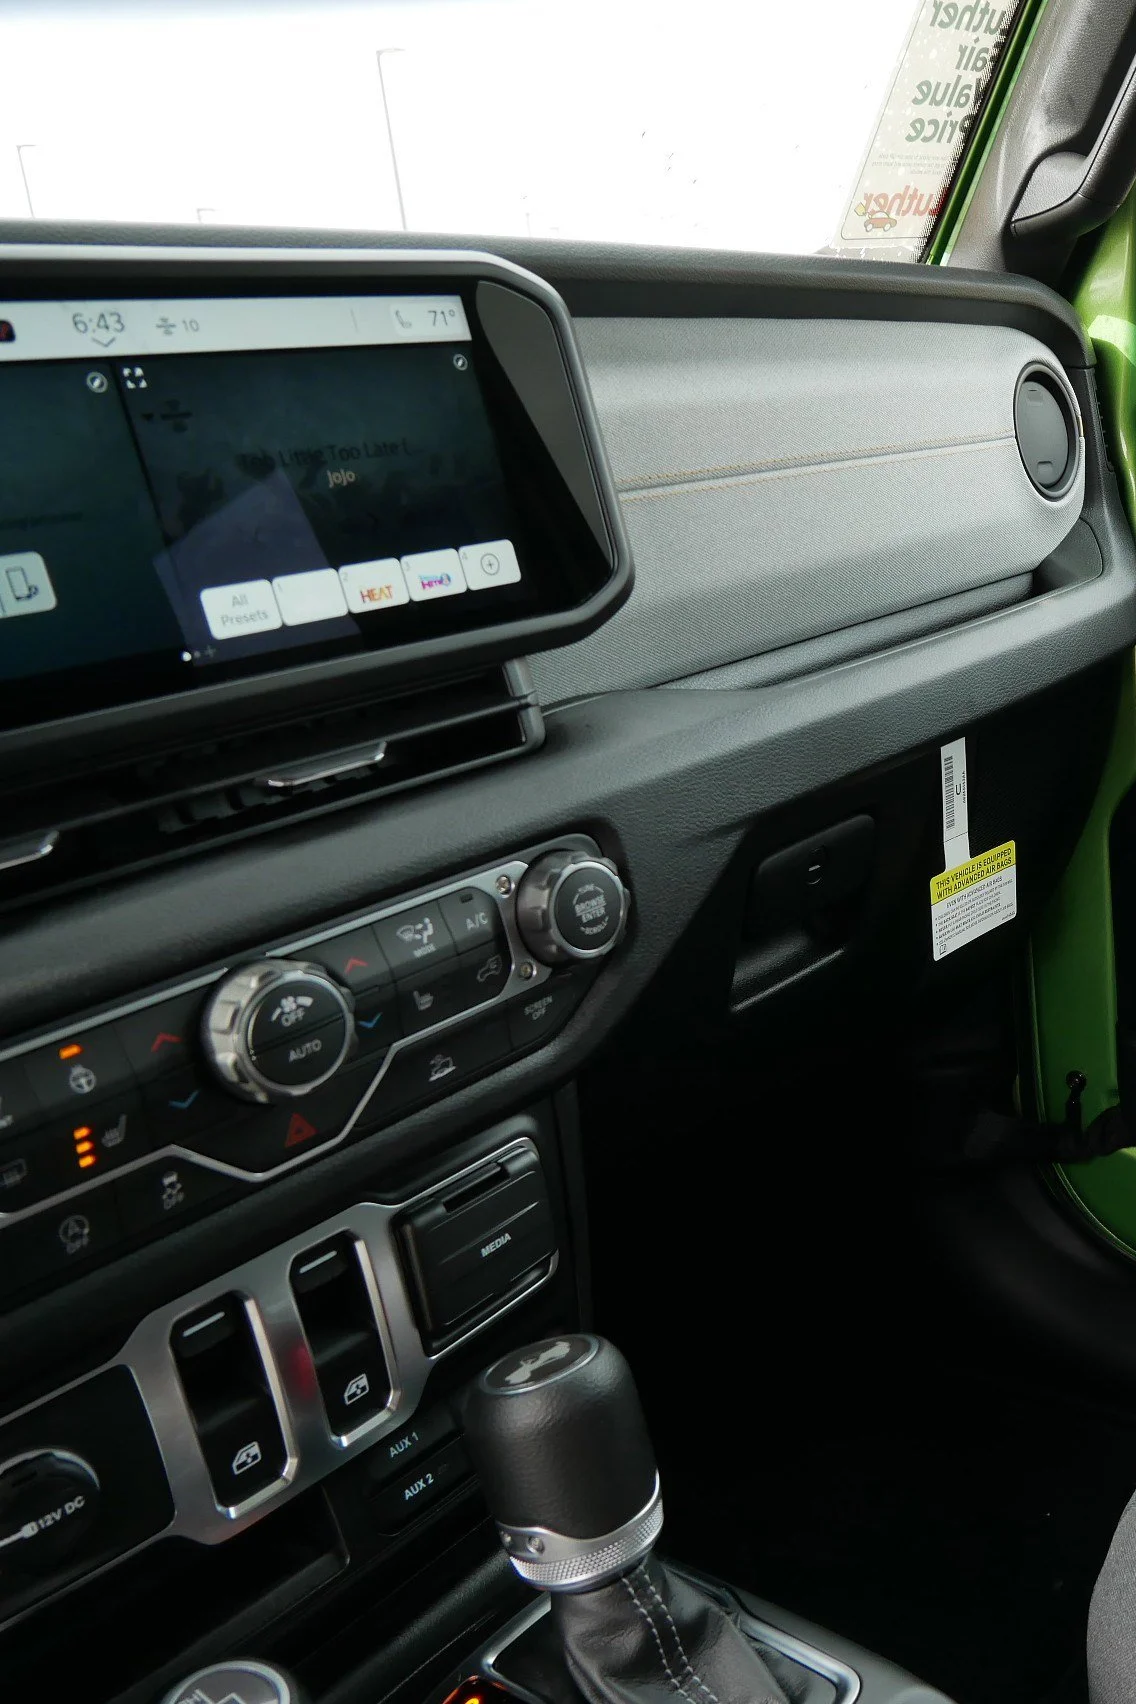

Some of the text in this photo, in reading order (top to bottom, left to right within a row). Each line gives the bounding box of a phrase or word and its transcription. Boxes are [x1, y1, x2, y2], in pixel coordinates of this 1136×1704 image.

[72, 312, 125, 334] 6:43
[182, 319, 199, 332] 10
[231, 593, 249, 607] All
[360, 584, 392, 603] HEAT
[220, 609, 269, 627] Presets
[936, 876, 950, 889] THIS
[950, 864, 975, 882] VEHICLE
[983, 847, 1012, 867] EQUIPPED
[936, 857, 1012, 900] WITH ADVANCED AIR BAGS
[466, 912, 489, 931] A/C
[281, 1007, 305, 1027] OFF
[289, 1039, 322, 1062] AUTO
[481, 1232, 512, 1257] MEDIA
[389, 1436, 413, 1458] AUX
[404, 1473, 434, 1501] AUX 2
[38, 1495, 86, 1529] 12V DC
